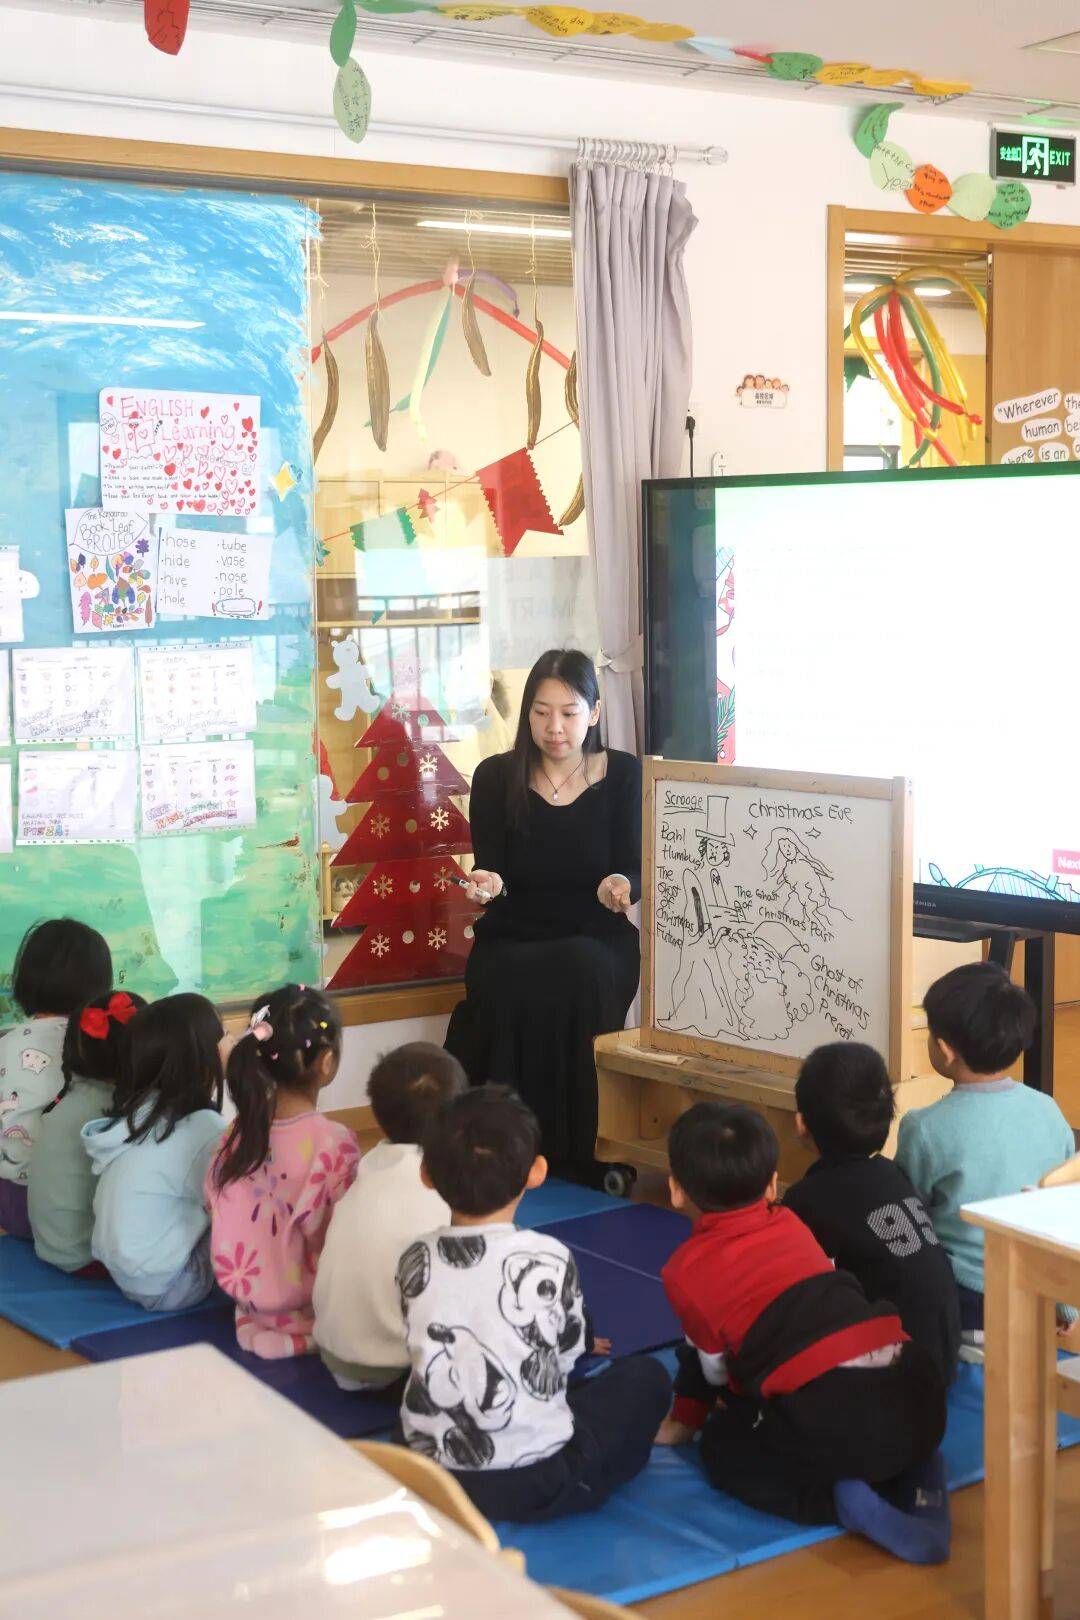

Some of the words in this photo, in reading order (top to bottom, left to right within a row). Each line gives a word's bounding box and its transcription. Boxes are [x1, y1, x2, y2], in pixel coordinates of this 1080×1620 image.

[1049, 150, 1070, 168] EXIT
[121, 396, 193, 418] ENGLISH
[163, 421, 235, 450] Learning
[1025, 422, 1060, 438] human
[1041, 448, 1050, 461] is
[1054, 449, 1066, 460] an
[112, 518, 136, 535] Leaf
[87, 531, 136, 552] PROJECT
[221, 539, 247, 553] tube
[165, 553, 190, 568] hide
[221, 556, 246, 571] vase
[164, 574, 187, 589] hive
[220, 572, 247, 584] nose
[164, 593, 186, 606] hole
[219, 586, 244, 600] pole
[664, 791, 704, 812] Scrooge
[749, 798, 824, 820] Christmas
[828, 804, 853, 824] Eve
[1057, 855, 1080, 870] Nex
[656, 866, 674, 881] The
[734, 885, 753, 899] The
[742, 899, 753, 910] of
[656, 907, 694, 931] Christmas
[758, 906, 806, 931] Christmas
[811, 955, 847, 982] Ghost
[848, 977, 864, 994] of
[814, 976, 870, 1030] Christmas
[819, 998, 855, 1040] Present
